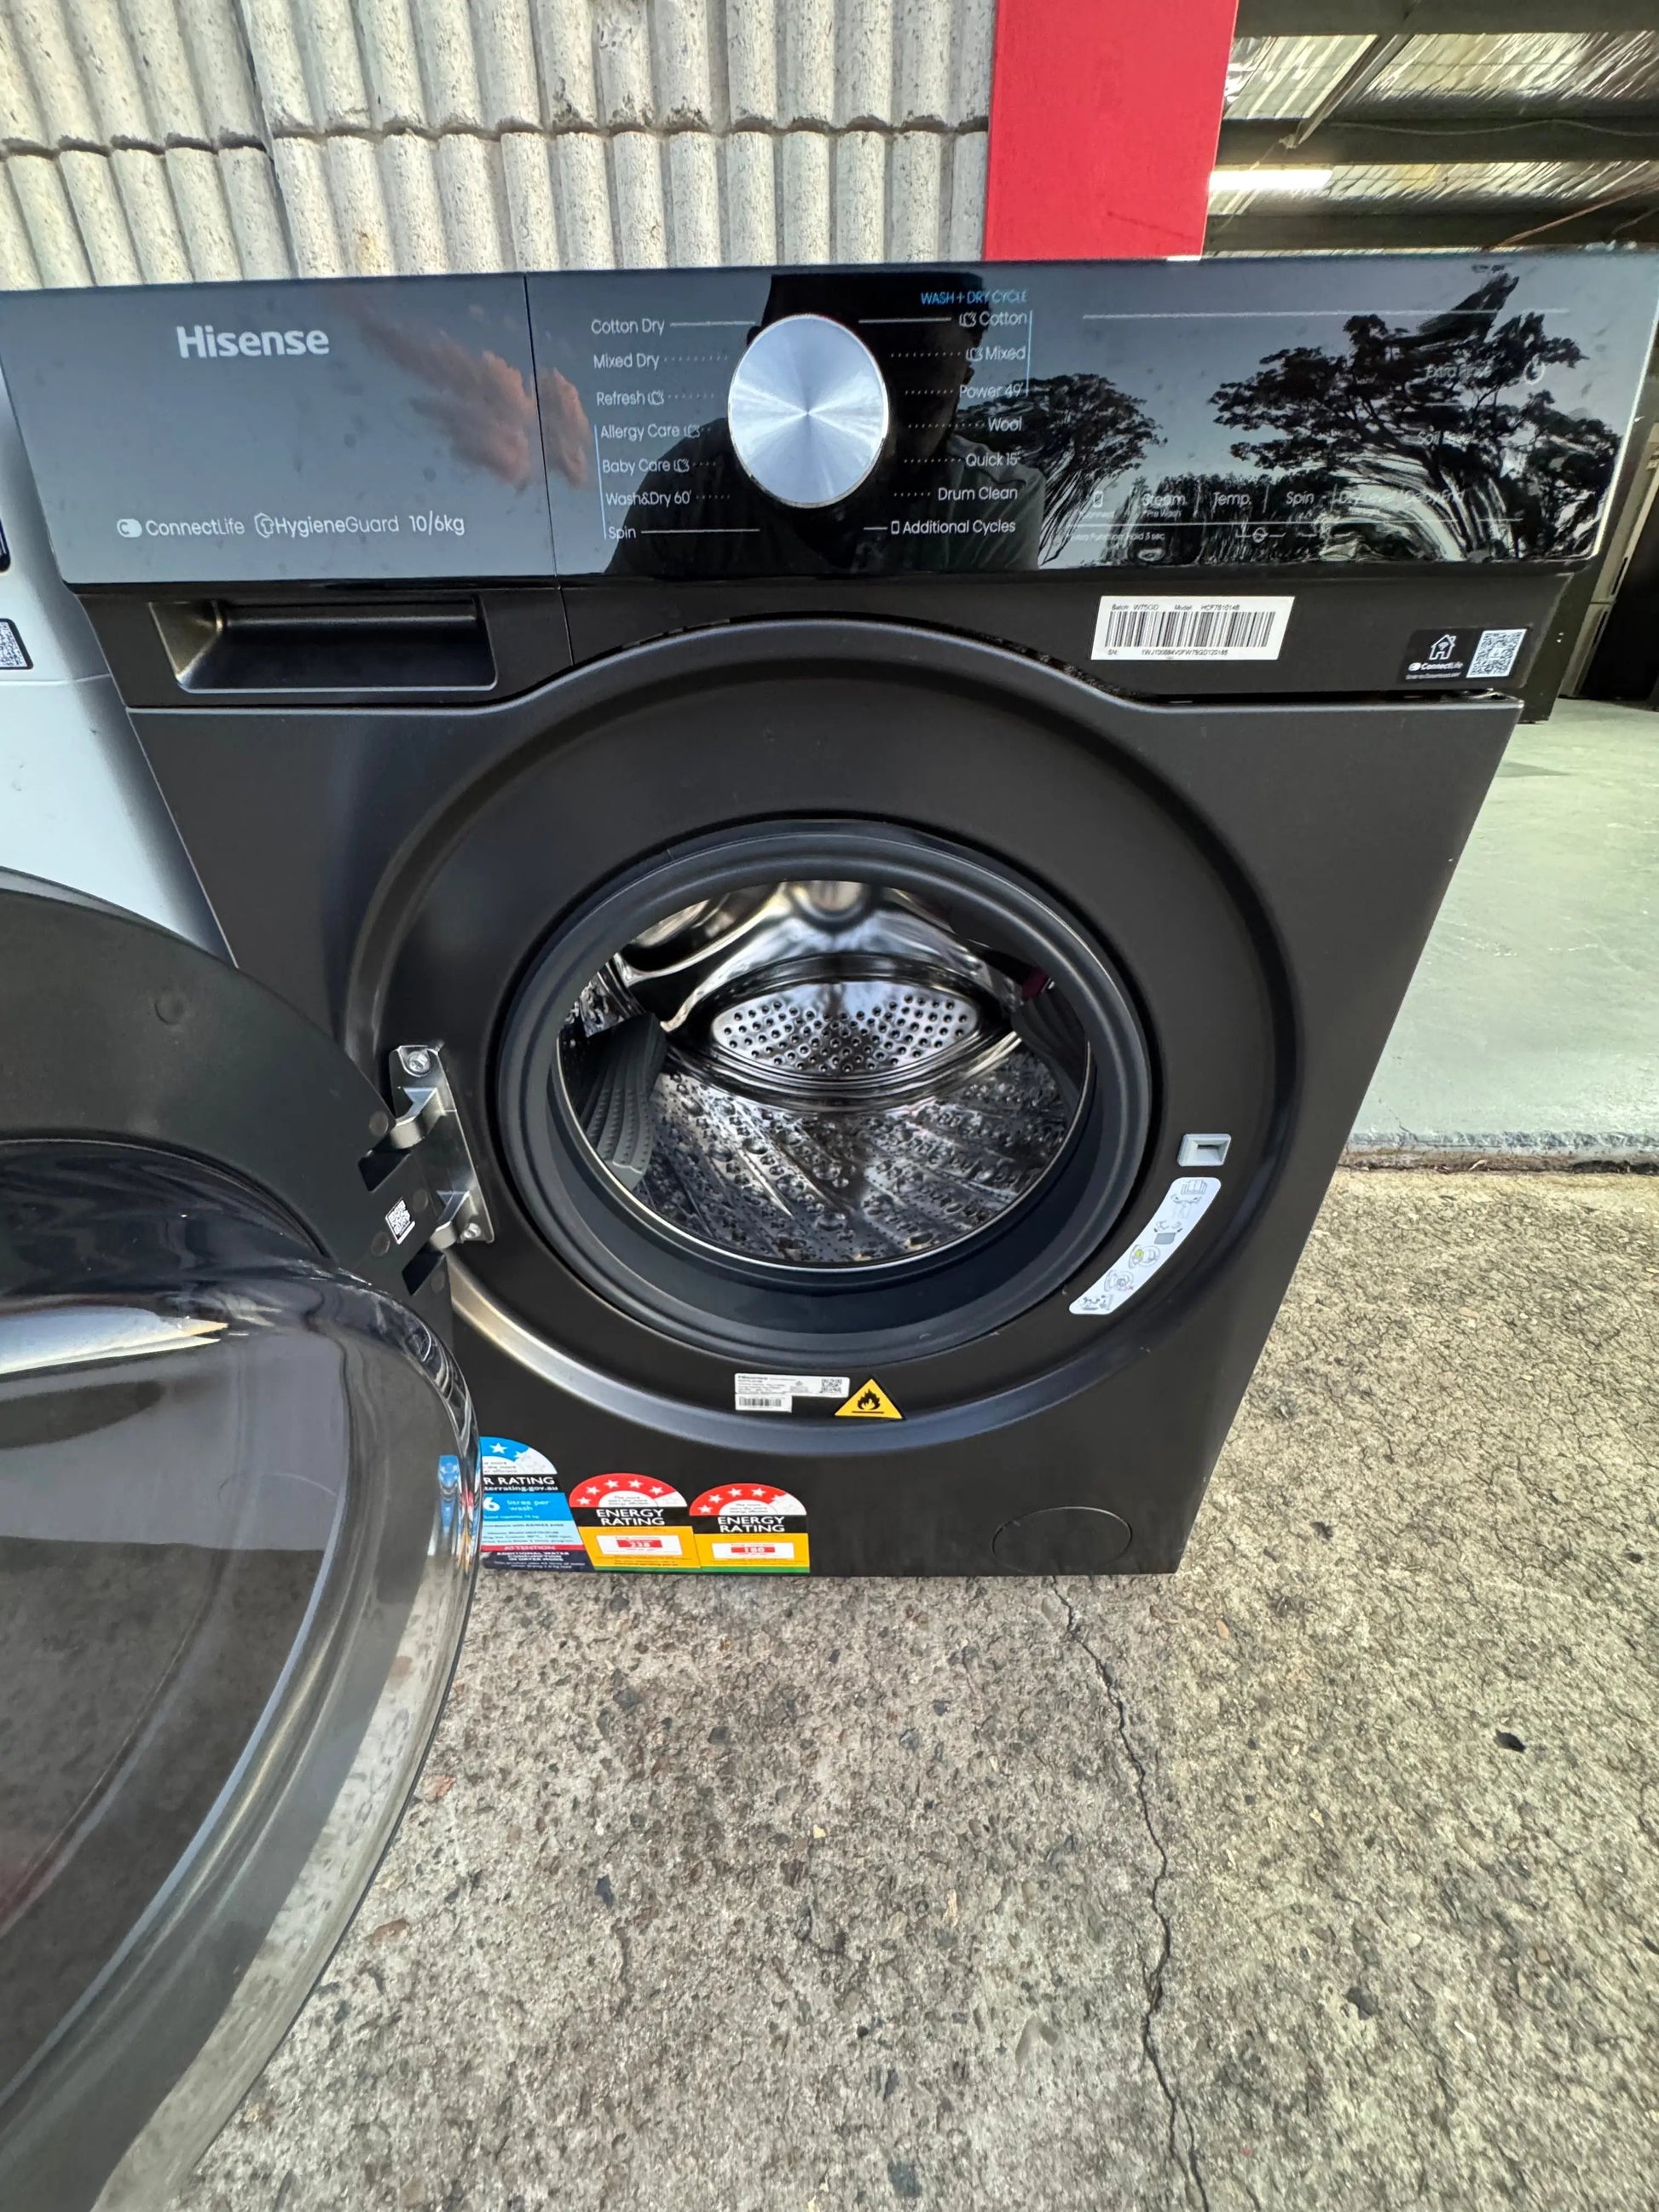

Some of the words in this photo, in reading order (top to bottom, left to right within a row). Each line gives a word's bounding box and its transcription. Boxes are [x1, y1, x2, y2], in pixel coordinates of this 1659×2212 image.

[921, 292, 954, 304] WASH
[967, 291, 989, 303] DRY
[991, 289, 1027, 303] CYCLE
[980, 310, 1027, 326] Cotton
[591, 319, 639, 334] Cotton
[642, 318, 665, 336] Dry
[176, 325, 330, 359] Hisense
[985, 344, 1026, 361] Mixed
[593, 352, 633, 369] Mixed
[637, 352, 660, 372] Dry
[597, 390, 645, 406] Refresh
[959, 384, 1001, 399] Power
[987, 416, 1023, 432] Wool
[600, 424, 645, 442] Allergy
[647, 423, 680, 438] Care
[602, 459, 636, 476] Baby
[639, 458, 671, 472] Care
[965, 452, 1003, 467] Quick
[605, 491, 672, 509] Wash&Dry
[938, 487, 975, 501] Drum
[978, 486, 1018, 500] Clean
[1286, 491, 1315, 505] Spin
[144, 517, 246, 537] ConnectLife
[276, 515, 399, 539] HygieneGuard
[408, 510, 465, 535] 10/6kg
[902, 520, 970, 535] Additional
[972, 518, 1016, 536] Cycles
[608, 525, 637, 541] Spin
[497, 1476, 555, 1485] RATING
[596, 1509, 664, 1518] ENERGY
[600, 1517, 665, 1526] RATING
[717, 1516, 785, 1525] ENERGY
[720, 1524, 785, 1533] RATING
